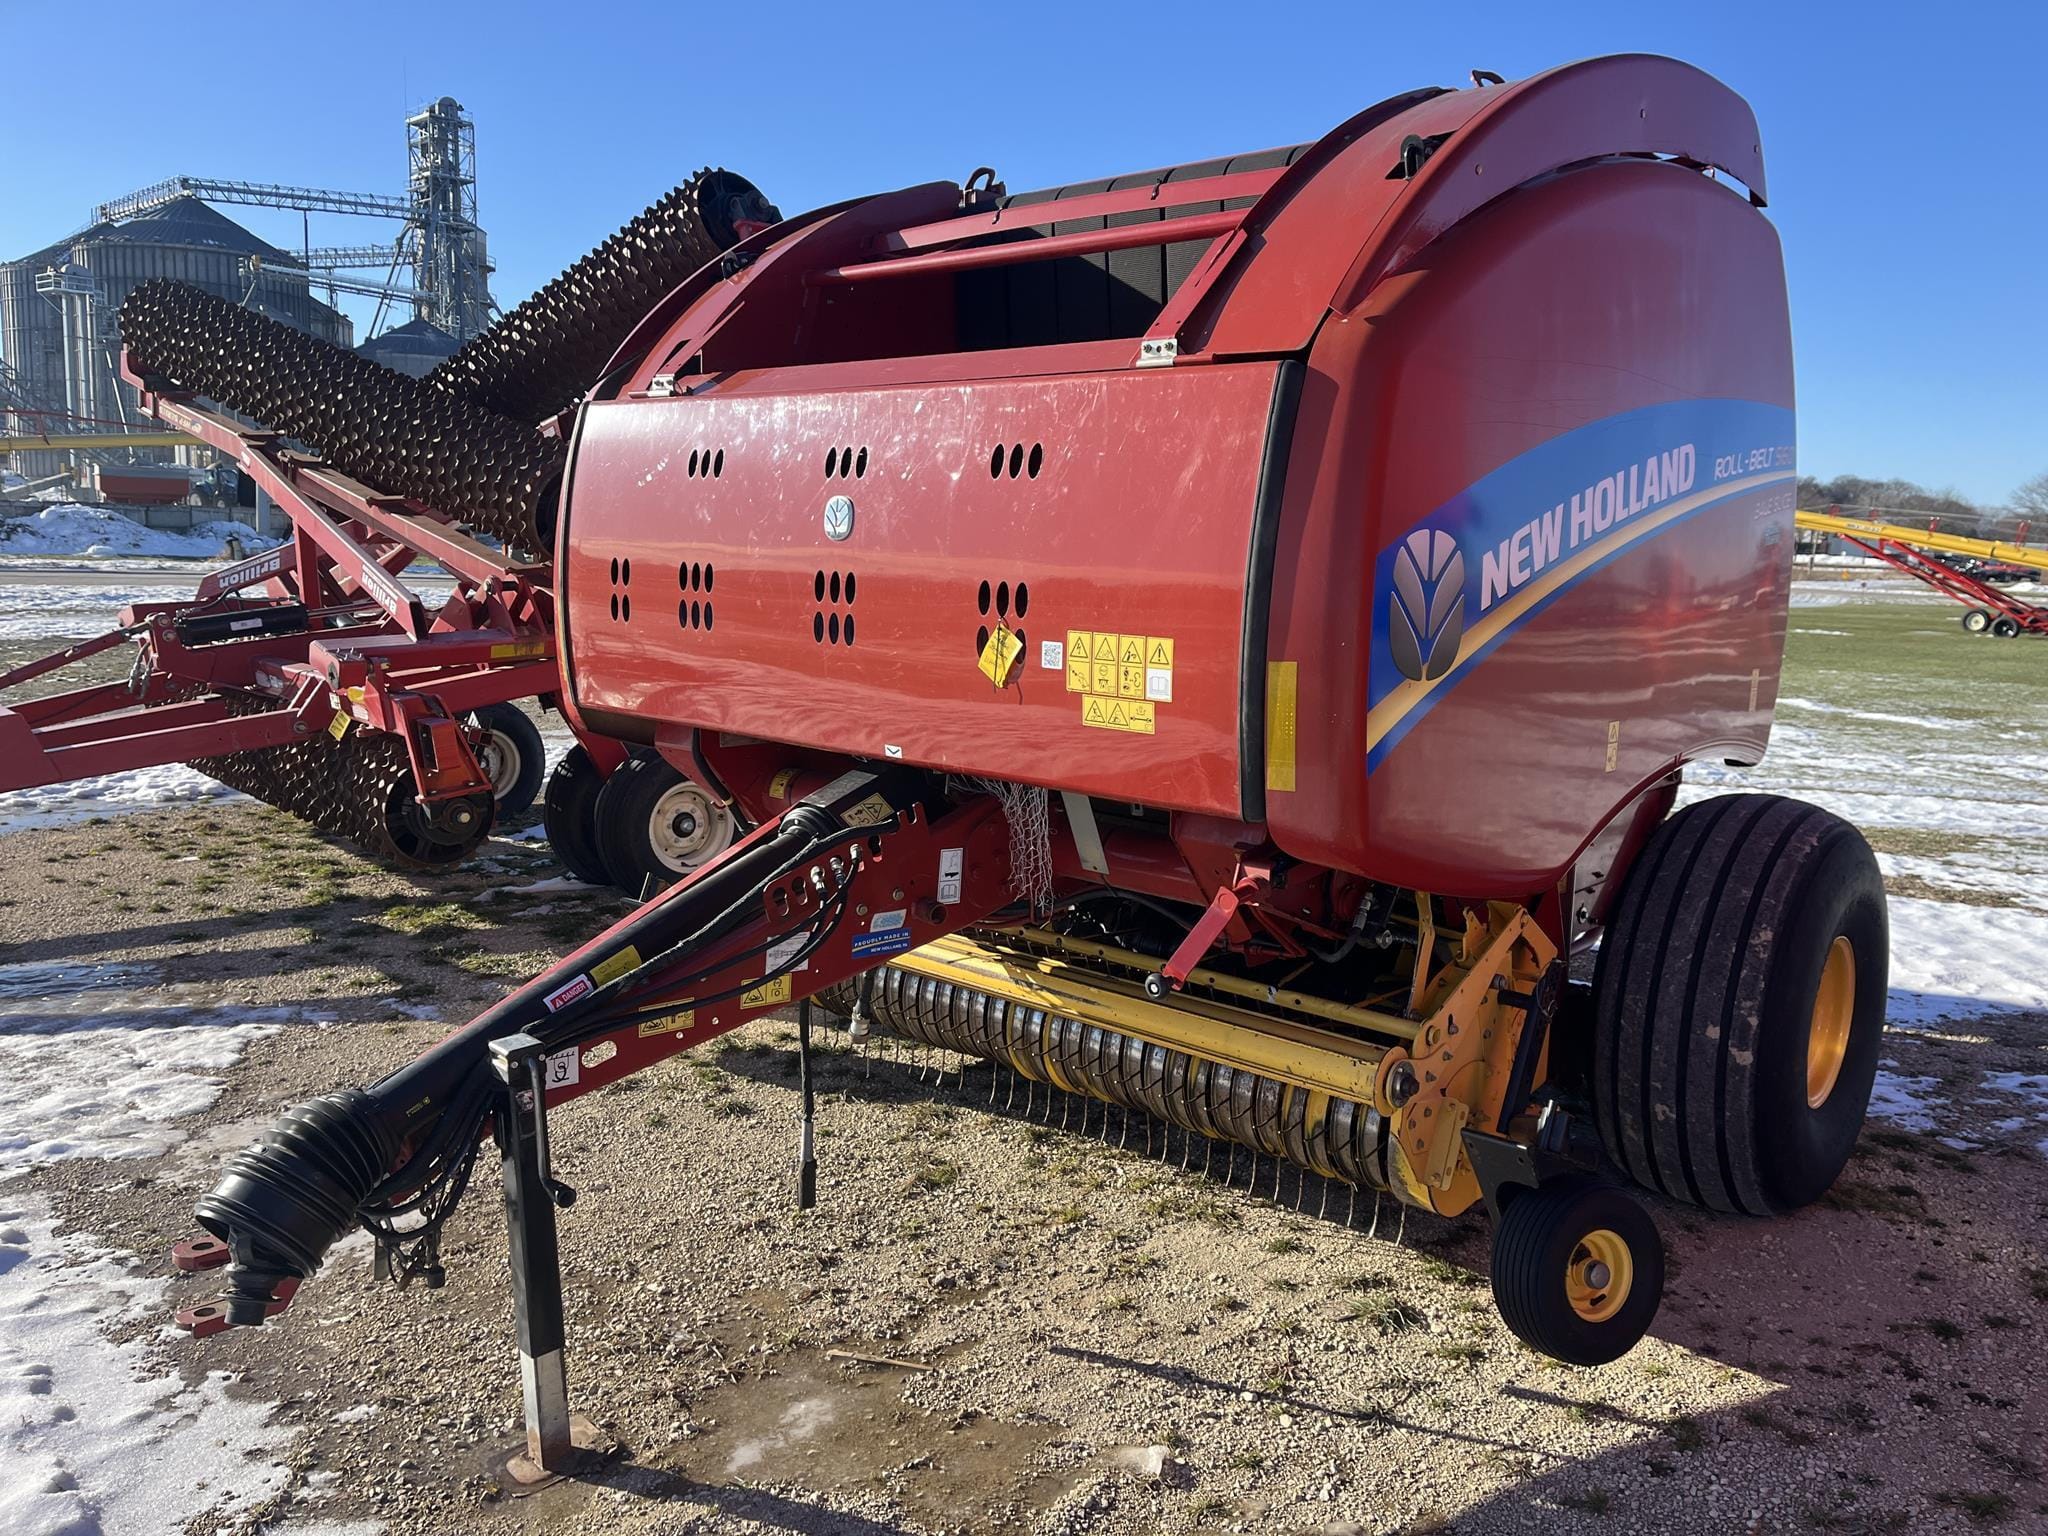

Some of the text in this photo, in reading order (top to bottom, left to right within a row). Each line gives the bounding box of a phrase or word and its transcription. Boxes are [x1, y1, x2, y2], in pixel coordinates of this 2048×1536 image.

[1481, 443, 1695, 611] NEW HOLLAND
[219, 557, 280, 588] Brillion
[361, 572, 397, 616] Brillion
[854, 937, 882, 947] PROUDLY
[562, 982, 586, 1002] DANGER
